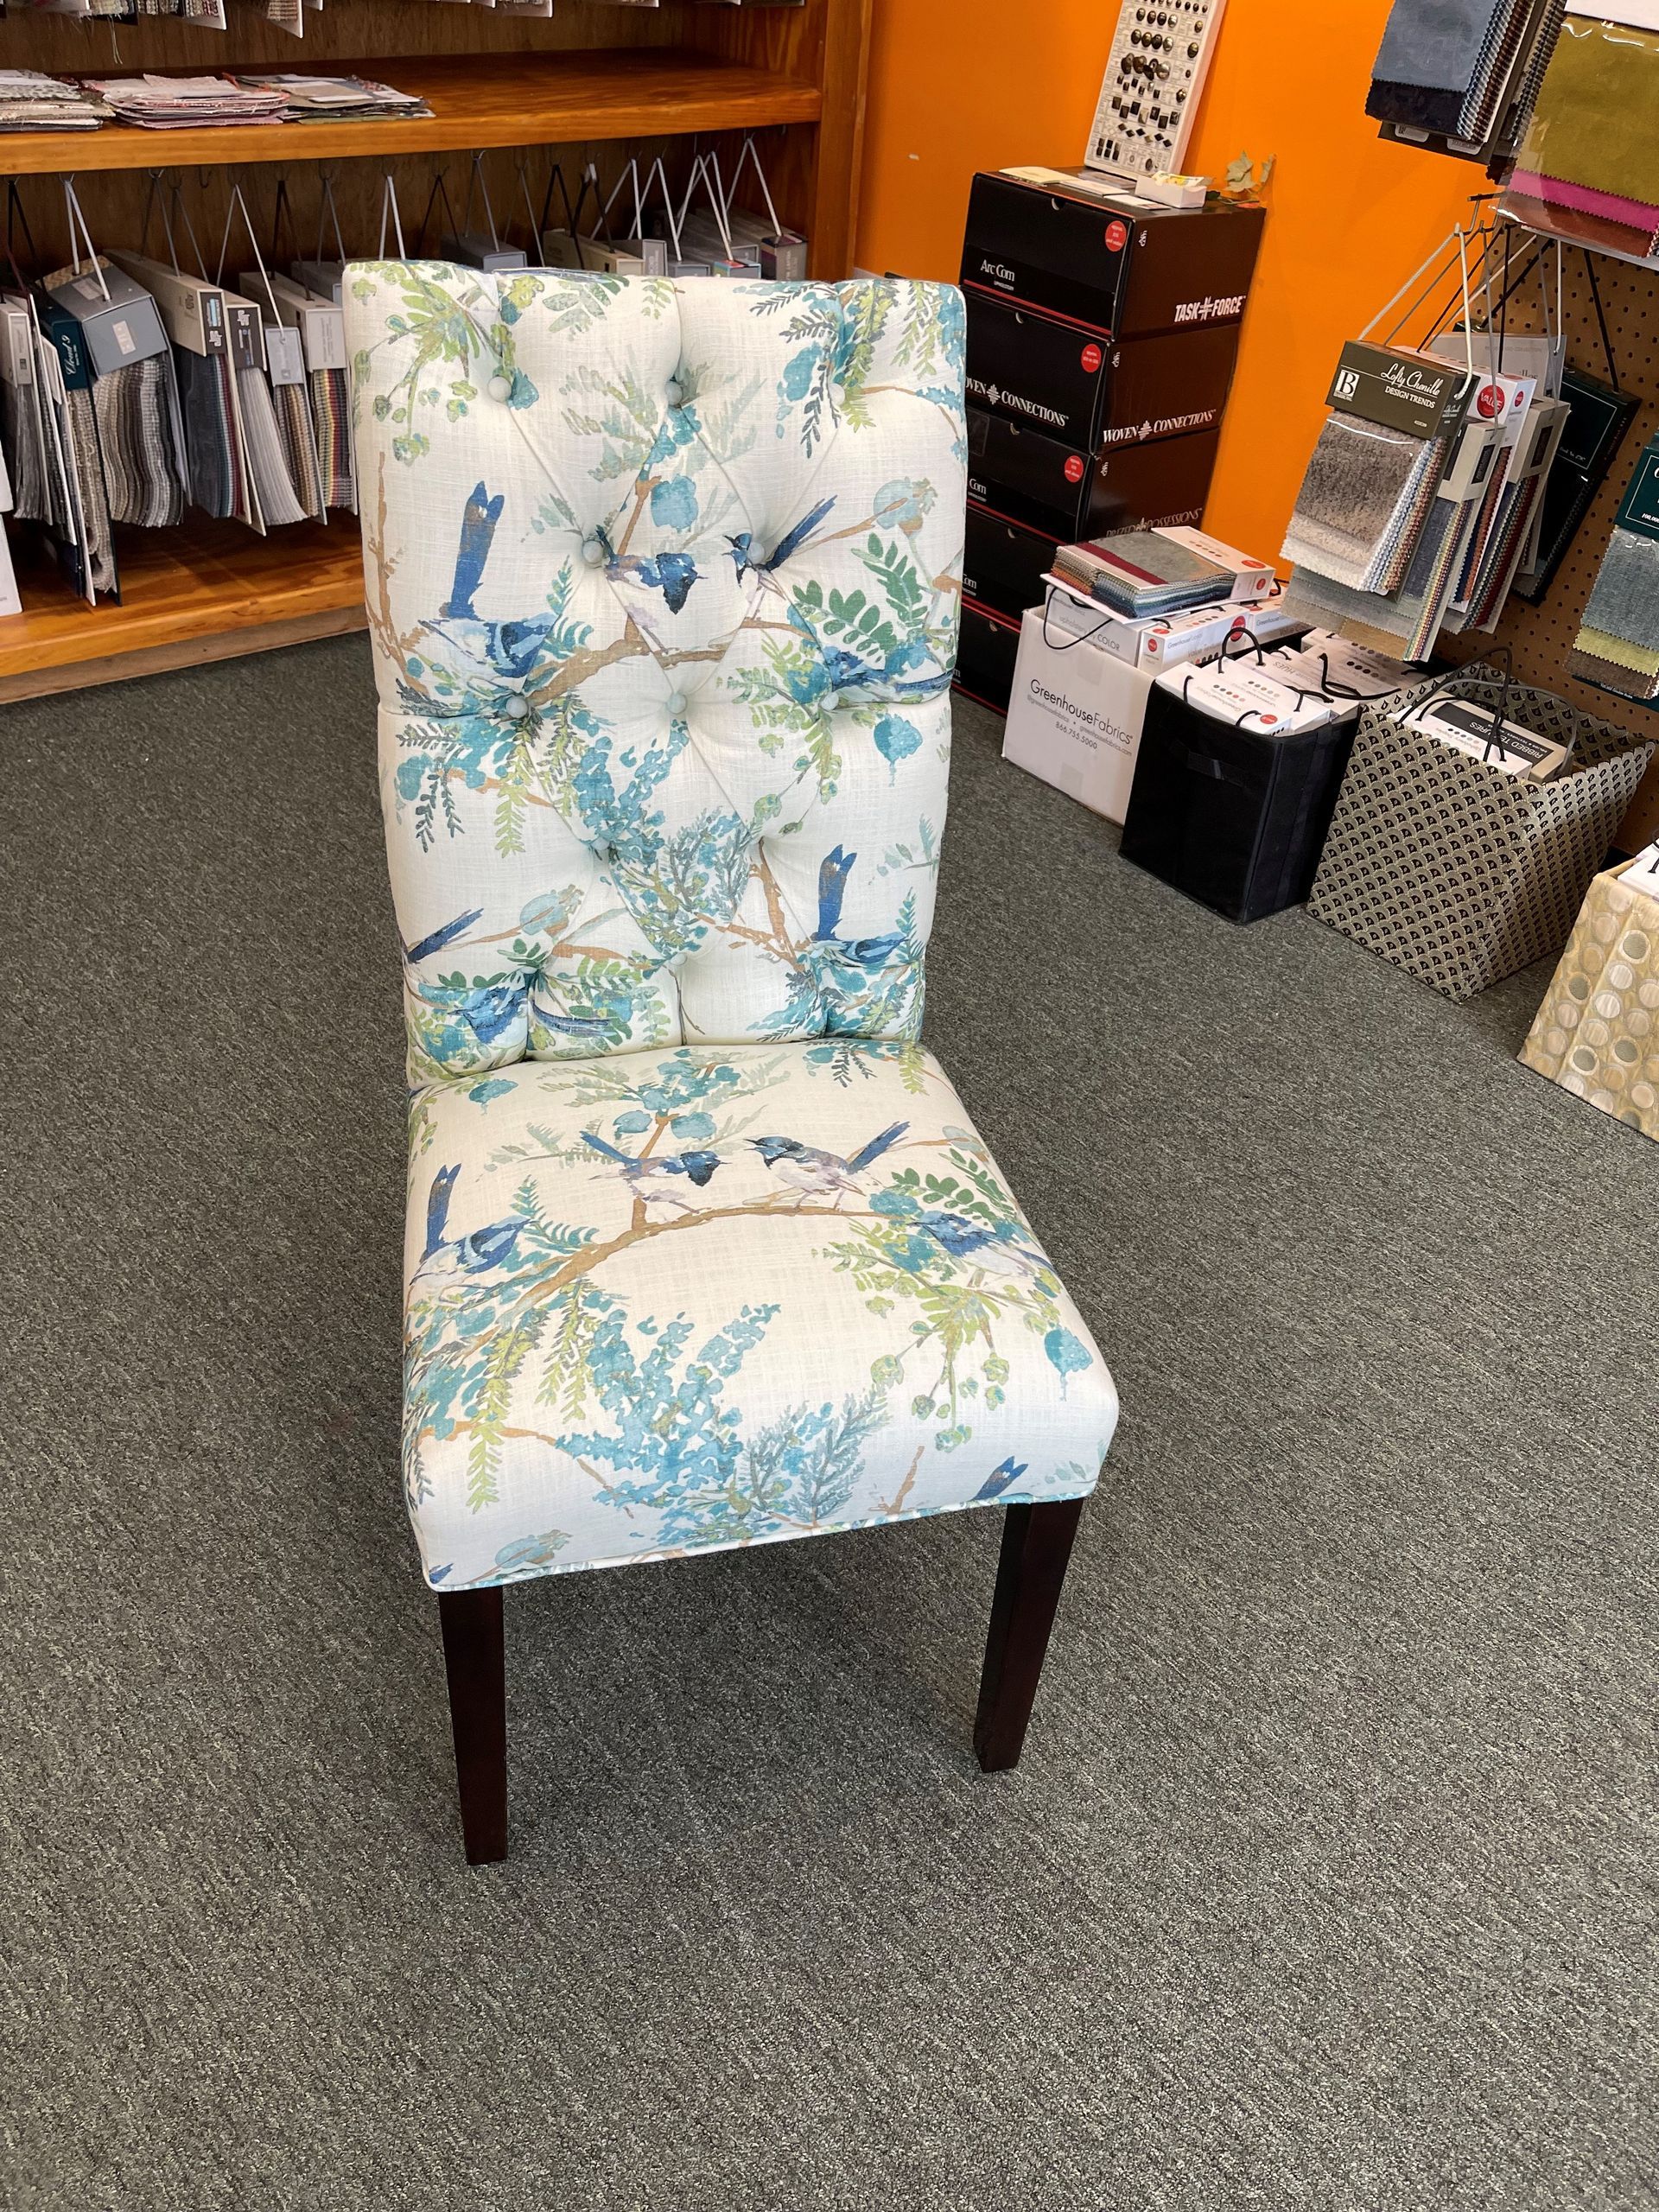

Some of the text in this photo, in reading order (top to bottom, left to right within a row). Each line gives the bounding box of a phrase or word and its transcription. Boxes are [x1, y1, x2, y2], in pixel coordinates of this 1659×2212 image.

[980, 259, 1015, 282] Arc Com
[1174, 296, 1243, 322] TASK FORCE
[1339, 371, 1357, 395] B
[1380, 363, 1444, 396] Lofty Chenille
[965, 376, 1066, 427] OVEN CONNECTIONS
[1385, 385, 1410, 400] DESIGN
[1409, 394, 1436, 409] TRENDS
[1480, 392, 1503, 411] VALUE
[1103, 410, 1214, 443] WOVEN CONNECTIONS
[969, 478, 987, 495] Com
[1096, 633, 1122, 652] COLOR
[1029, 678, 1132, 745] GreenhouseFabrics
[1055, 721, 1098, 750] 866.755.5000
[1469, 721, 1510, 745] TEURES
[1510, 741, 1544, 760] RIBBED
